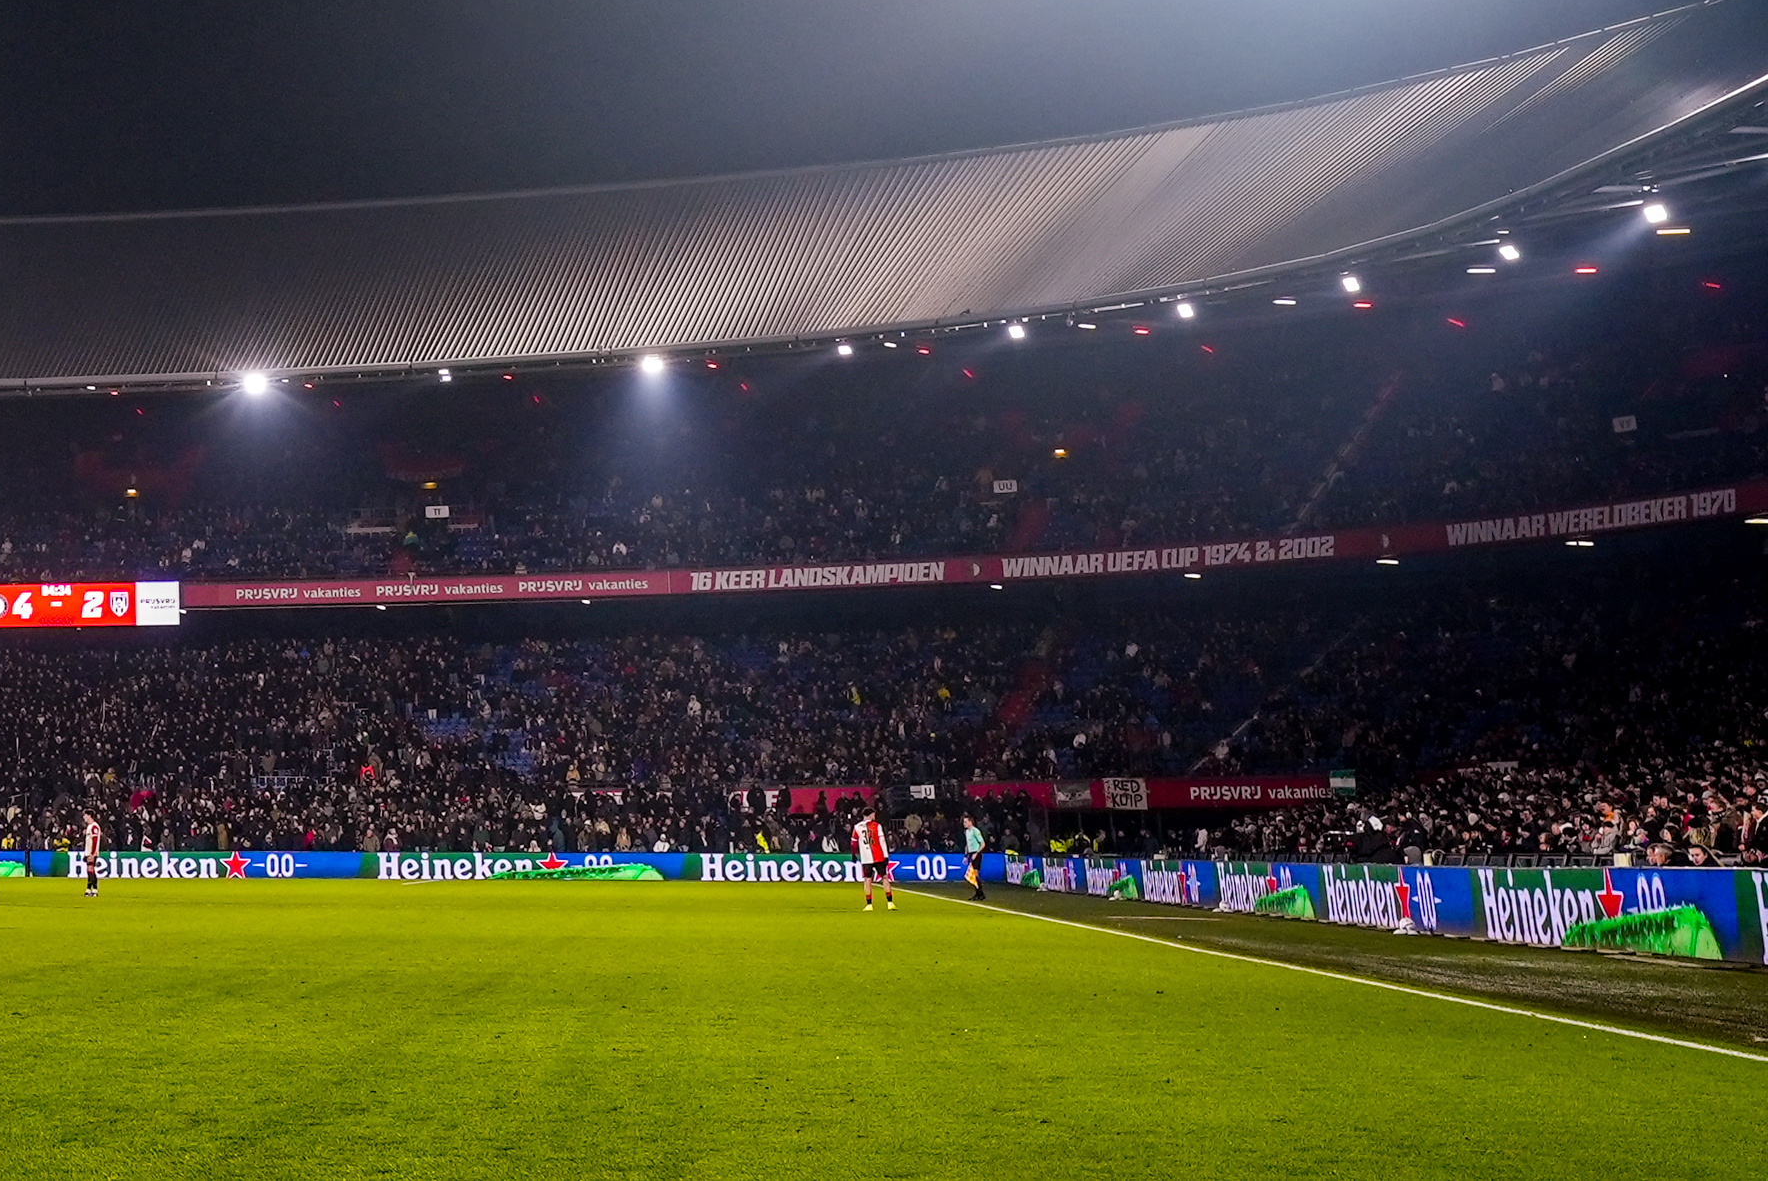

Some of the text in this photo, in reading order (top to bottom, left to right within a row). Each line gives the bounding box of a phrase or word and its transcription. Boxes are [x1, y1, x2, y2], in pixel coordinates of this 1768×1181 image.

[1446, 488, 1736, 546] WINNAAR WERELDBEKER 1970
[1001, 553, 1103, 578] WINNAAR
[1107, 549, 1158, 573] UEFA
[1161, 546, 1199, 569] CUP
[1202, 542, 1252, 566] 1974
[1279, 535, 1335, 560] 2002
[588, 577, 648, 592] vakanties
[691, 562, 945, 591] 16 KEER LANDSKAMPIOEN
[303, 587, 361, 599] vakanties
[444, 582, 503, 595] vakanties
[12, 592, 33, 619] 4
[81, 591, 104, 618] 2
[1113, 779, 1140, 793] RED
[1268, 784, 1331, 799] vakanties
[1112, 793, 1143, 808] KUIP
[68, 851, 219, 878] Heineken
[1323, 865, 1400, 929] Heineken
